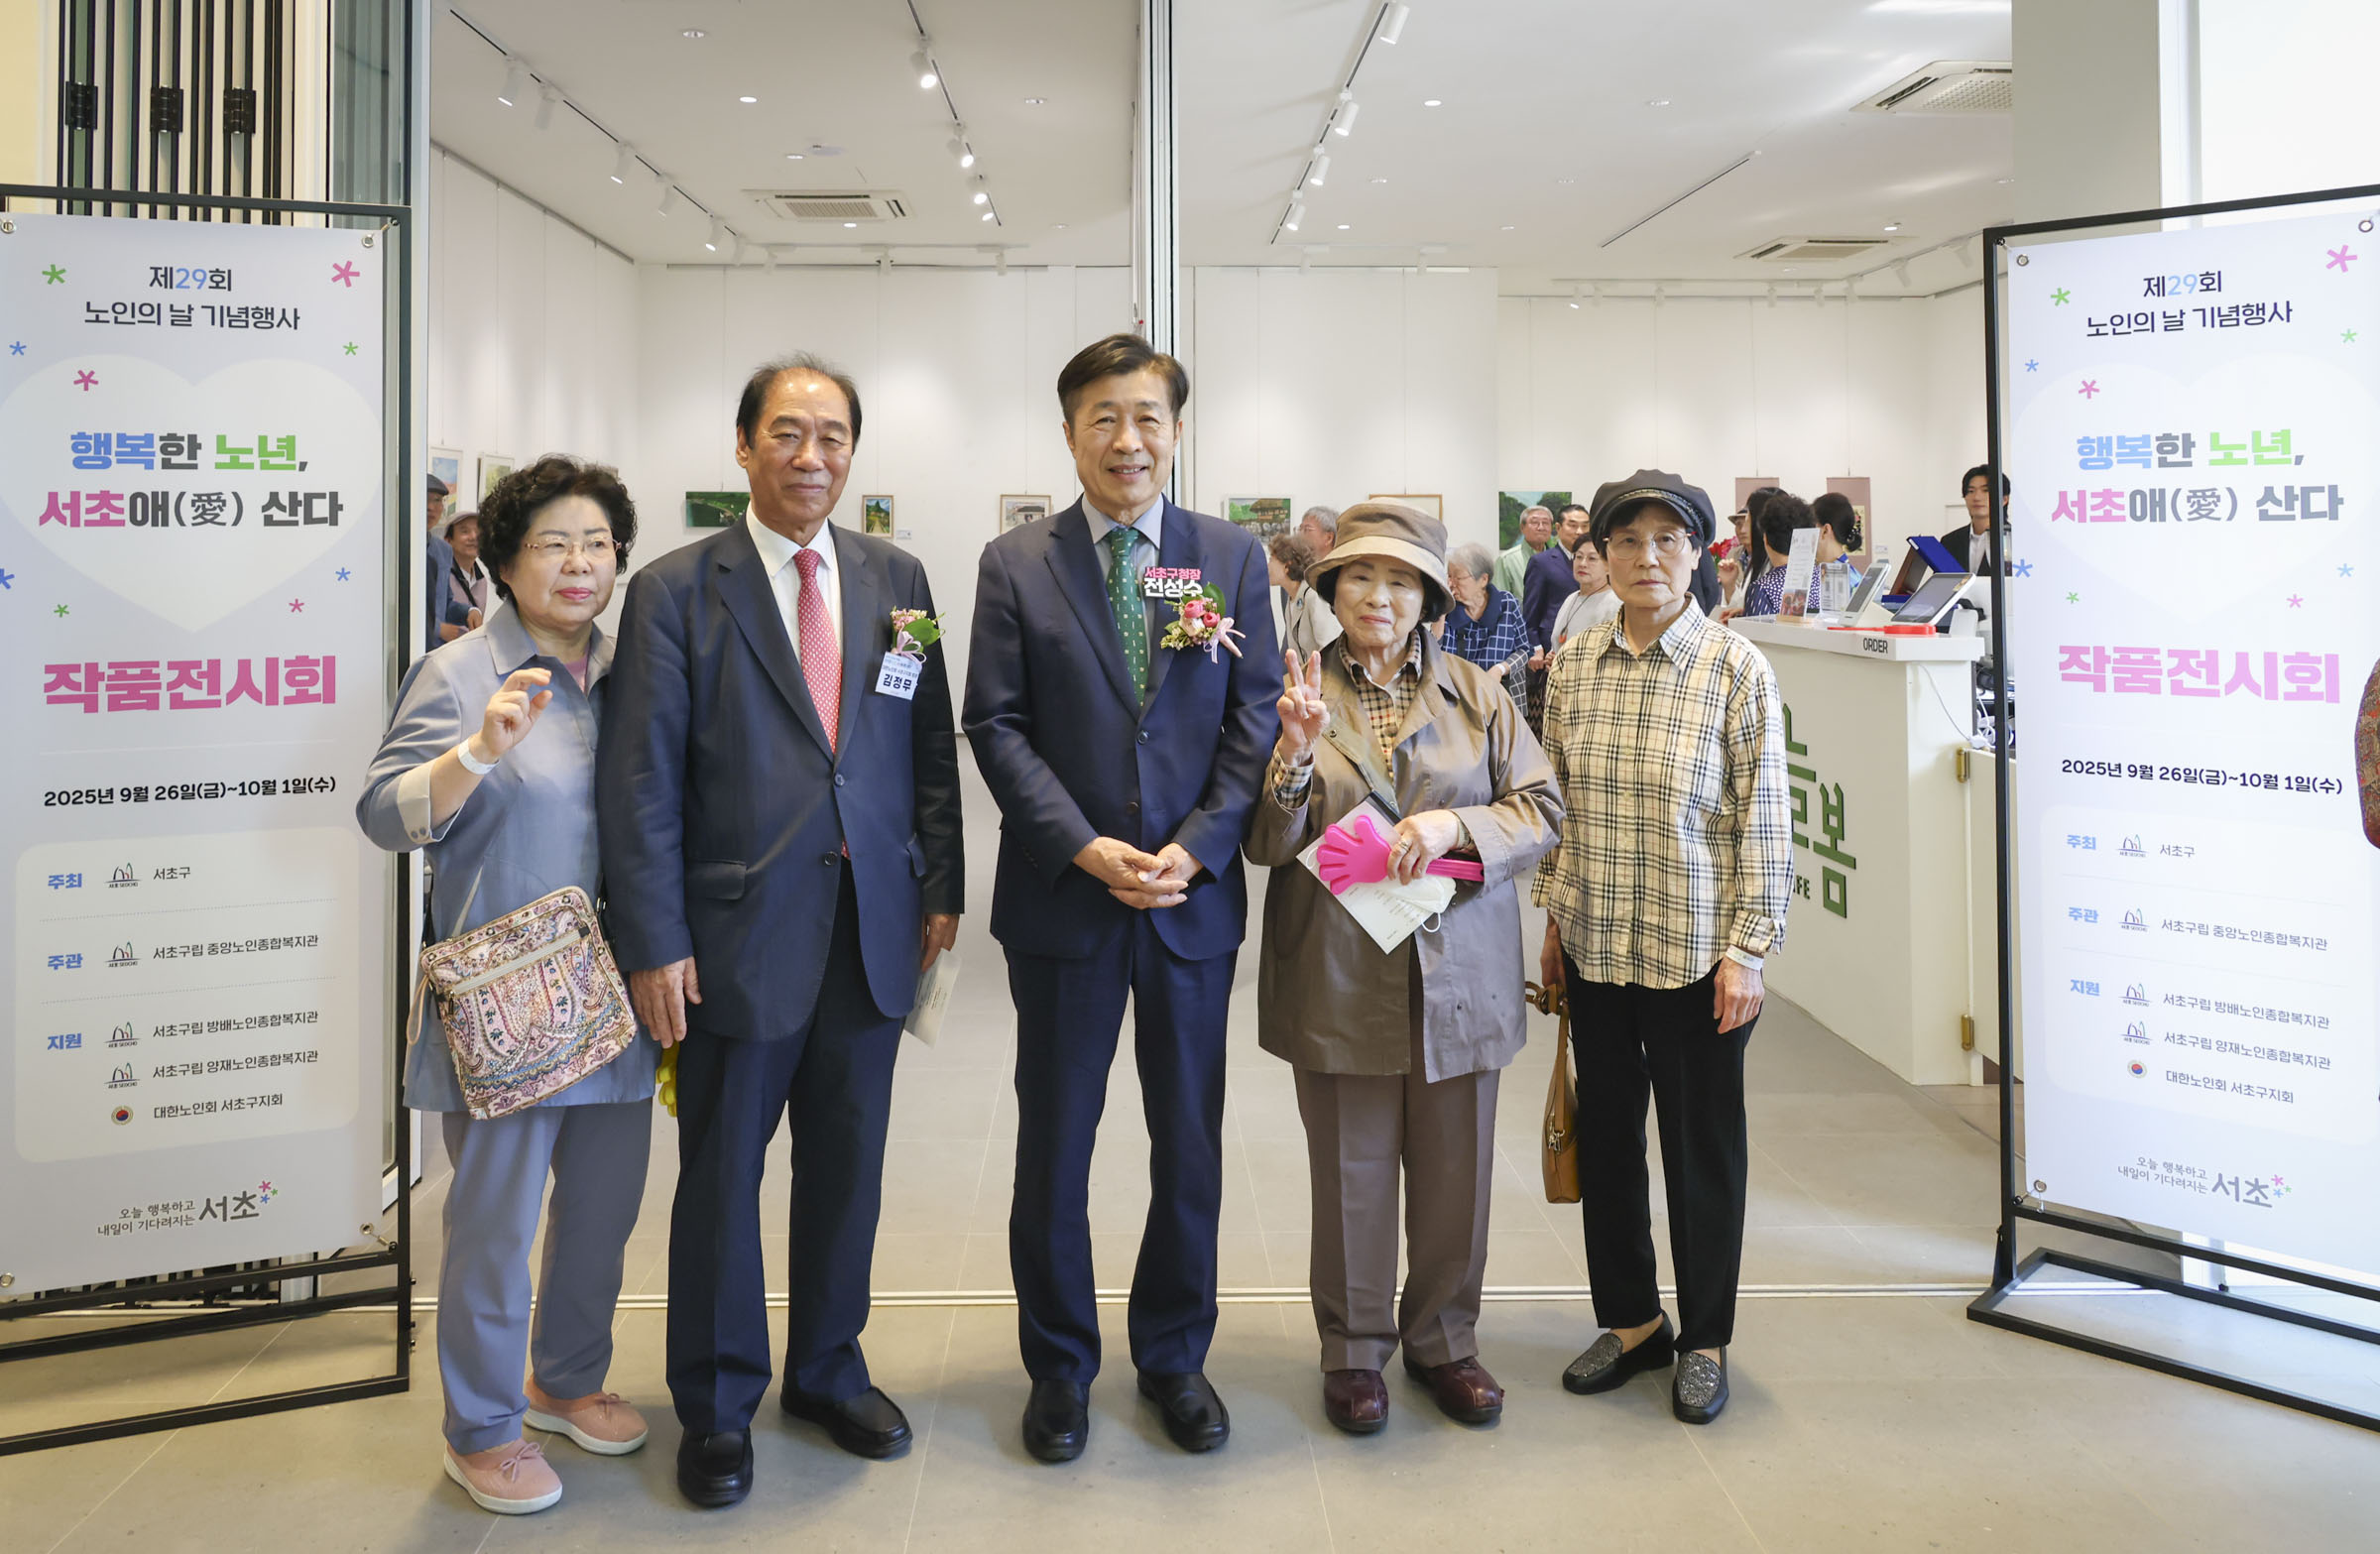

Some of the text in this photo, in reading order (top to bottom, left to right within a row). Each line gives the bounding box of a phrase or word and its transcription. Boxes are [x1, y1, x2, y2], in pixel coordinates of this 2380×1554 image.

[150, 267, 231, 292] 제29회
[2144, 271, 2221, 297] 제29회
[85, 301, 299, 330] 노인의 날 기념행사
[2087, 300, 2293, 336] 노인의 날 기념행사
[70, 432, 308, 472] 행복한 노년,
[2077, 429, 2304, 470] 행복한 노년,
[40, 490, 343, 528] 서초애(愛) 산다
[2052, 485, 2344, 523] 서초애(愛) 산다
[1144, 566, 1202, 580] 서초구청장
[1143, 578, 1203, 597] 전성수
[1863, 638, 1888, 655] ORDER
[44, 656, 335, 713] 작품전시회
[883, 673, 912, 692] 김정무
[2059, 645, 2340, 703] 작품전시회
[2063, 760, 2342, 794] 2025년 9월 26일(금)~10월 1일(수)
[45, 777, 335, 806] 2025년 9월 26일(금)~10월 1일(수)
[2067, 835, 2095, 850] 주최
[2160, 844, 2195, 857] 서초구
[48, 873, 82, 890] 주최
[154, 867, 190, 880] 서초구
[1793, 875, 1811, 899] FE
[2069, 907, 2098, 923] 주관
[154, 935, 318, 959] 서초구립 중앙노인종합복지관
[2162, 919, 2327, 951] 서초구립 중앙노인종합복지관
[48, 953, 83, 970] 주관
[2071, 979, 2099, 996] 지원
[153, 1011, 318, 1037] 서초구립 방배노인종합복지관
[2163, 994, 2329, 1029] 서초구립 방배노인종합복지관
[48, 1033, 81, 1050] 지원
[2165, 1032, 2330, 1070] 서초구립 양재노인종합복지관
[153, 1050, 318, 1078] 서초구립 양재노인종합복지관
[2166, 1071, 2293, 1103] 대한노인회 서초구지회
[154, 1094, 282, 1119] 대한노인회 서초구지회
[2118, 1166, 2207, 1194] 내일이 기다려지는
[2137, 1157, 2207, 1179] 오늘 행복하고
[2211, 1173, 2273, 1208] 서초
[119, 1201, 195, 1219] 오늘 행복하고
[199, 1190, 260, 1222] 서초
[98, 1215, 195, 1236] 내일이 기다려지는
